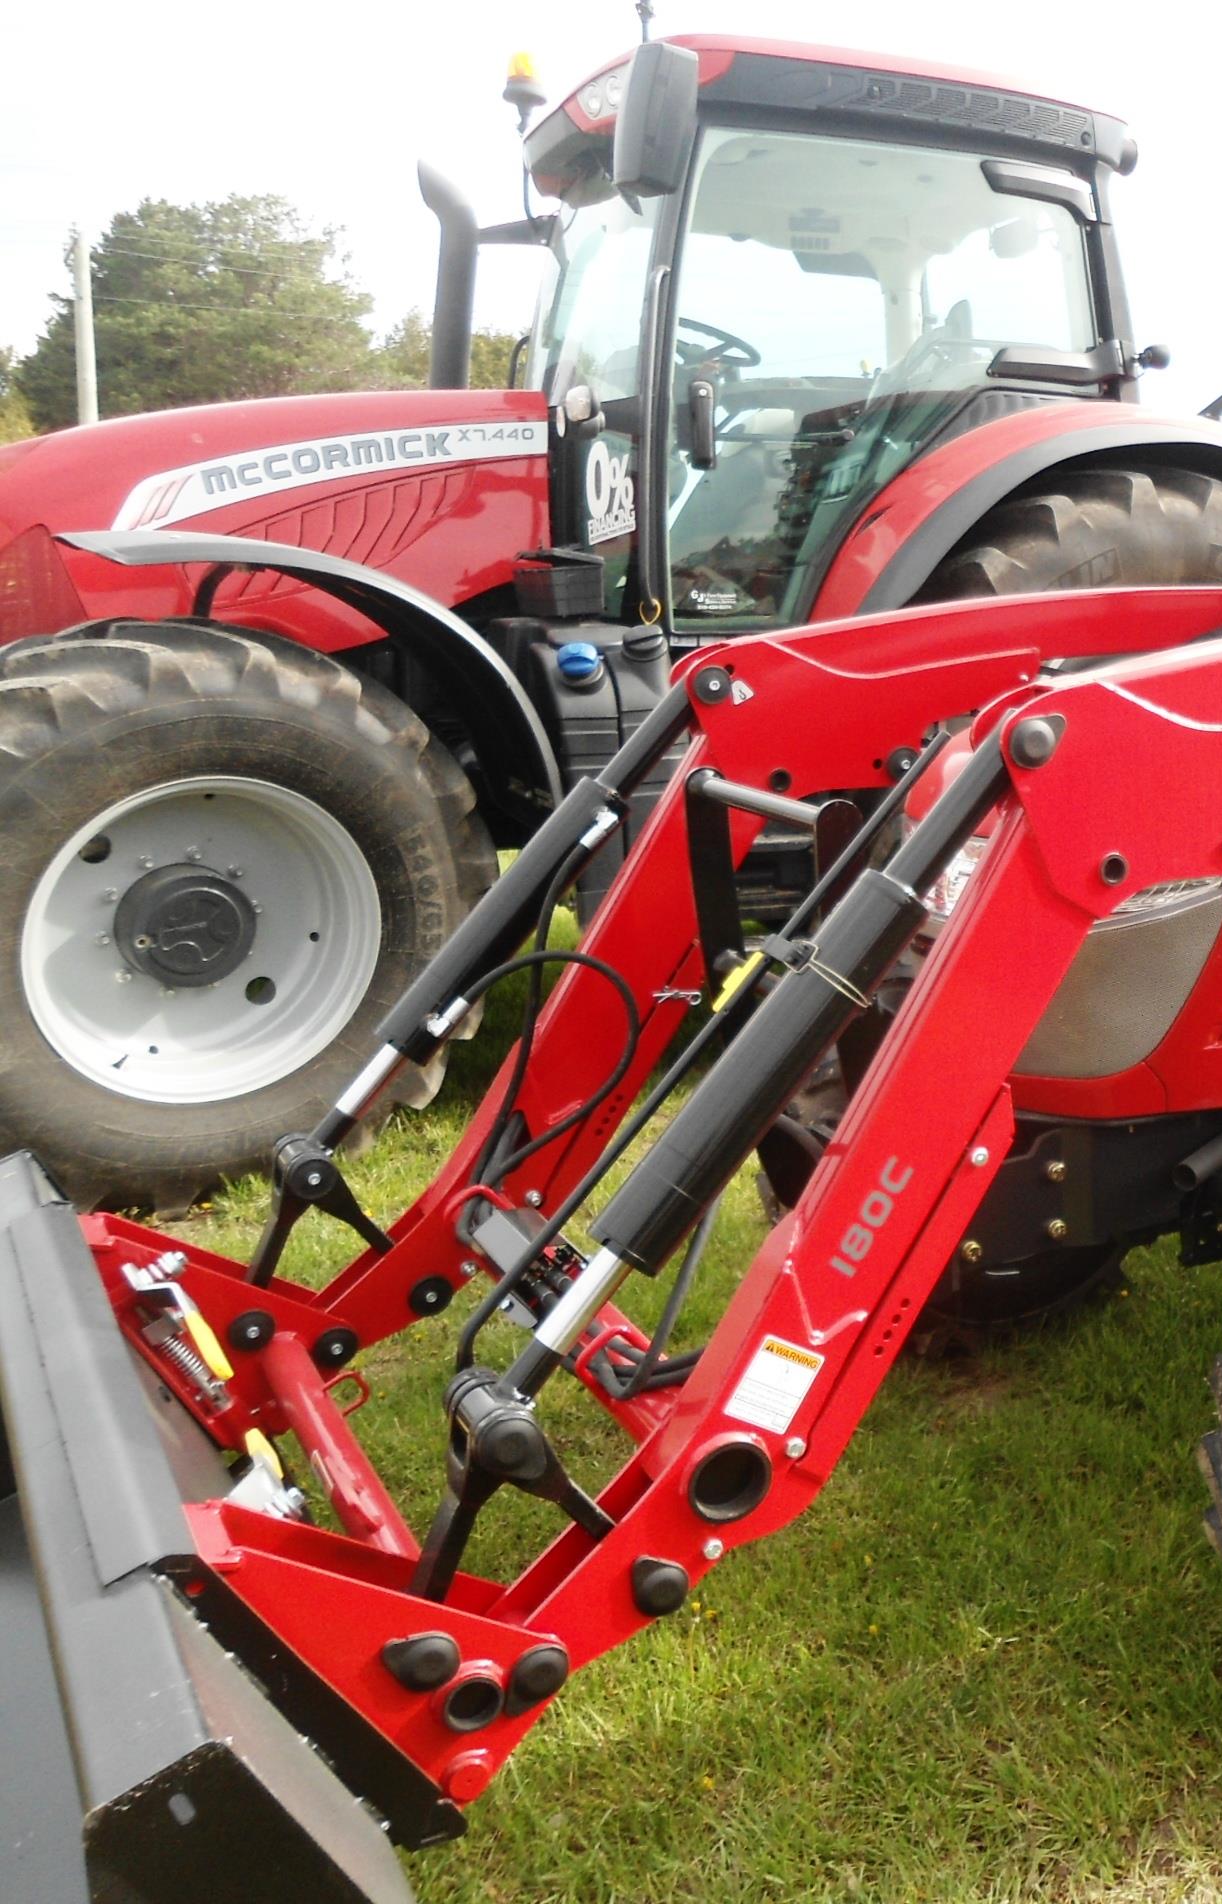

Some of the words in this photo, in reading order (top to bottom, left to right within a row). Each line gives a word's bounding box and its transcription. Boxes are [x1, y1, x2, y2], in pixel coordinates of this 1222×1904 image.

[201, 432, 452, 495] McCORMICK
[457, 428, 534, 442] X7.440
[586, 441, 635, 518] 0%
[829, 1154, 915, 1278] 180C
[775, 1346, 819, 1369] WARNING
